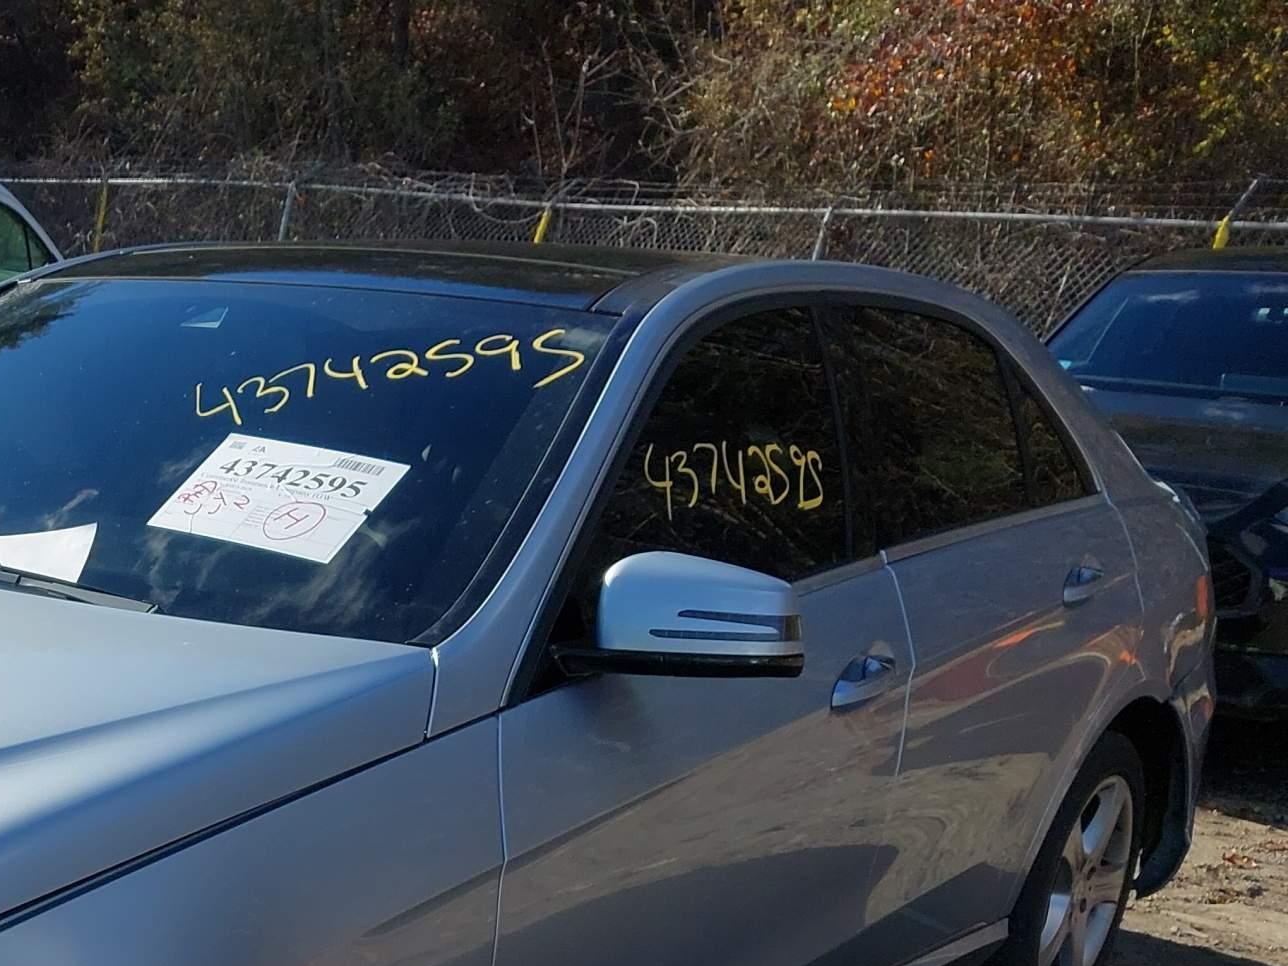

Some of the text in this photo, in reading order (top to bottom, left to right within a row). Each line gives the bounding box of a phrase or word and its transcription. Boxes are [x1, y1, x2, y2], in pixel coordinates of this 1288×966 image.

[194, 328, 586, 426] 43742595
[219, 458, 368, 499] 43742595
[644, 440, 824, 521] 43742595
